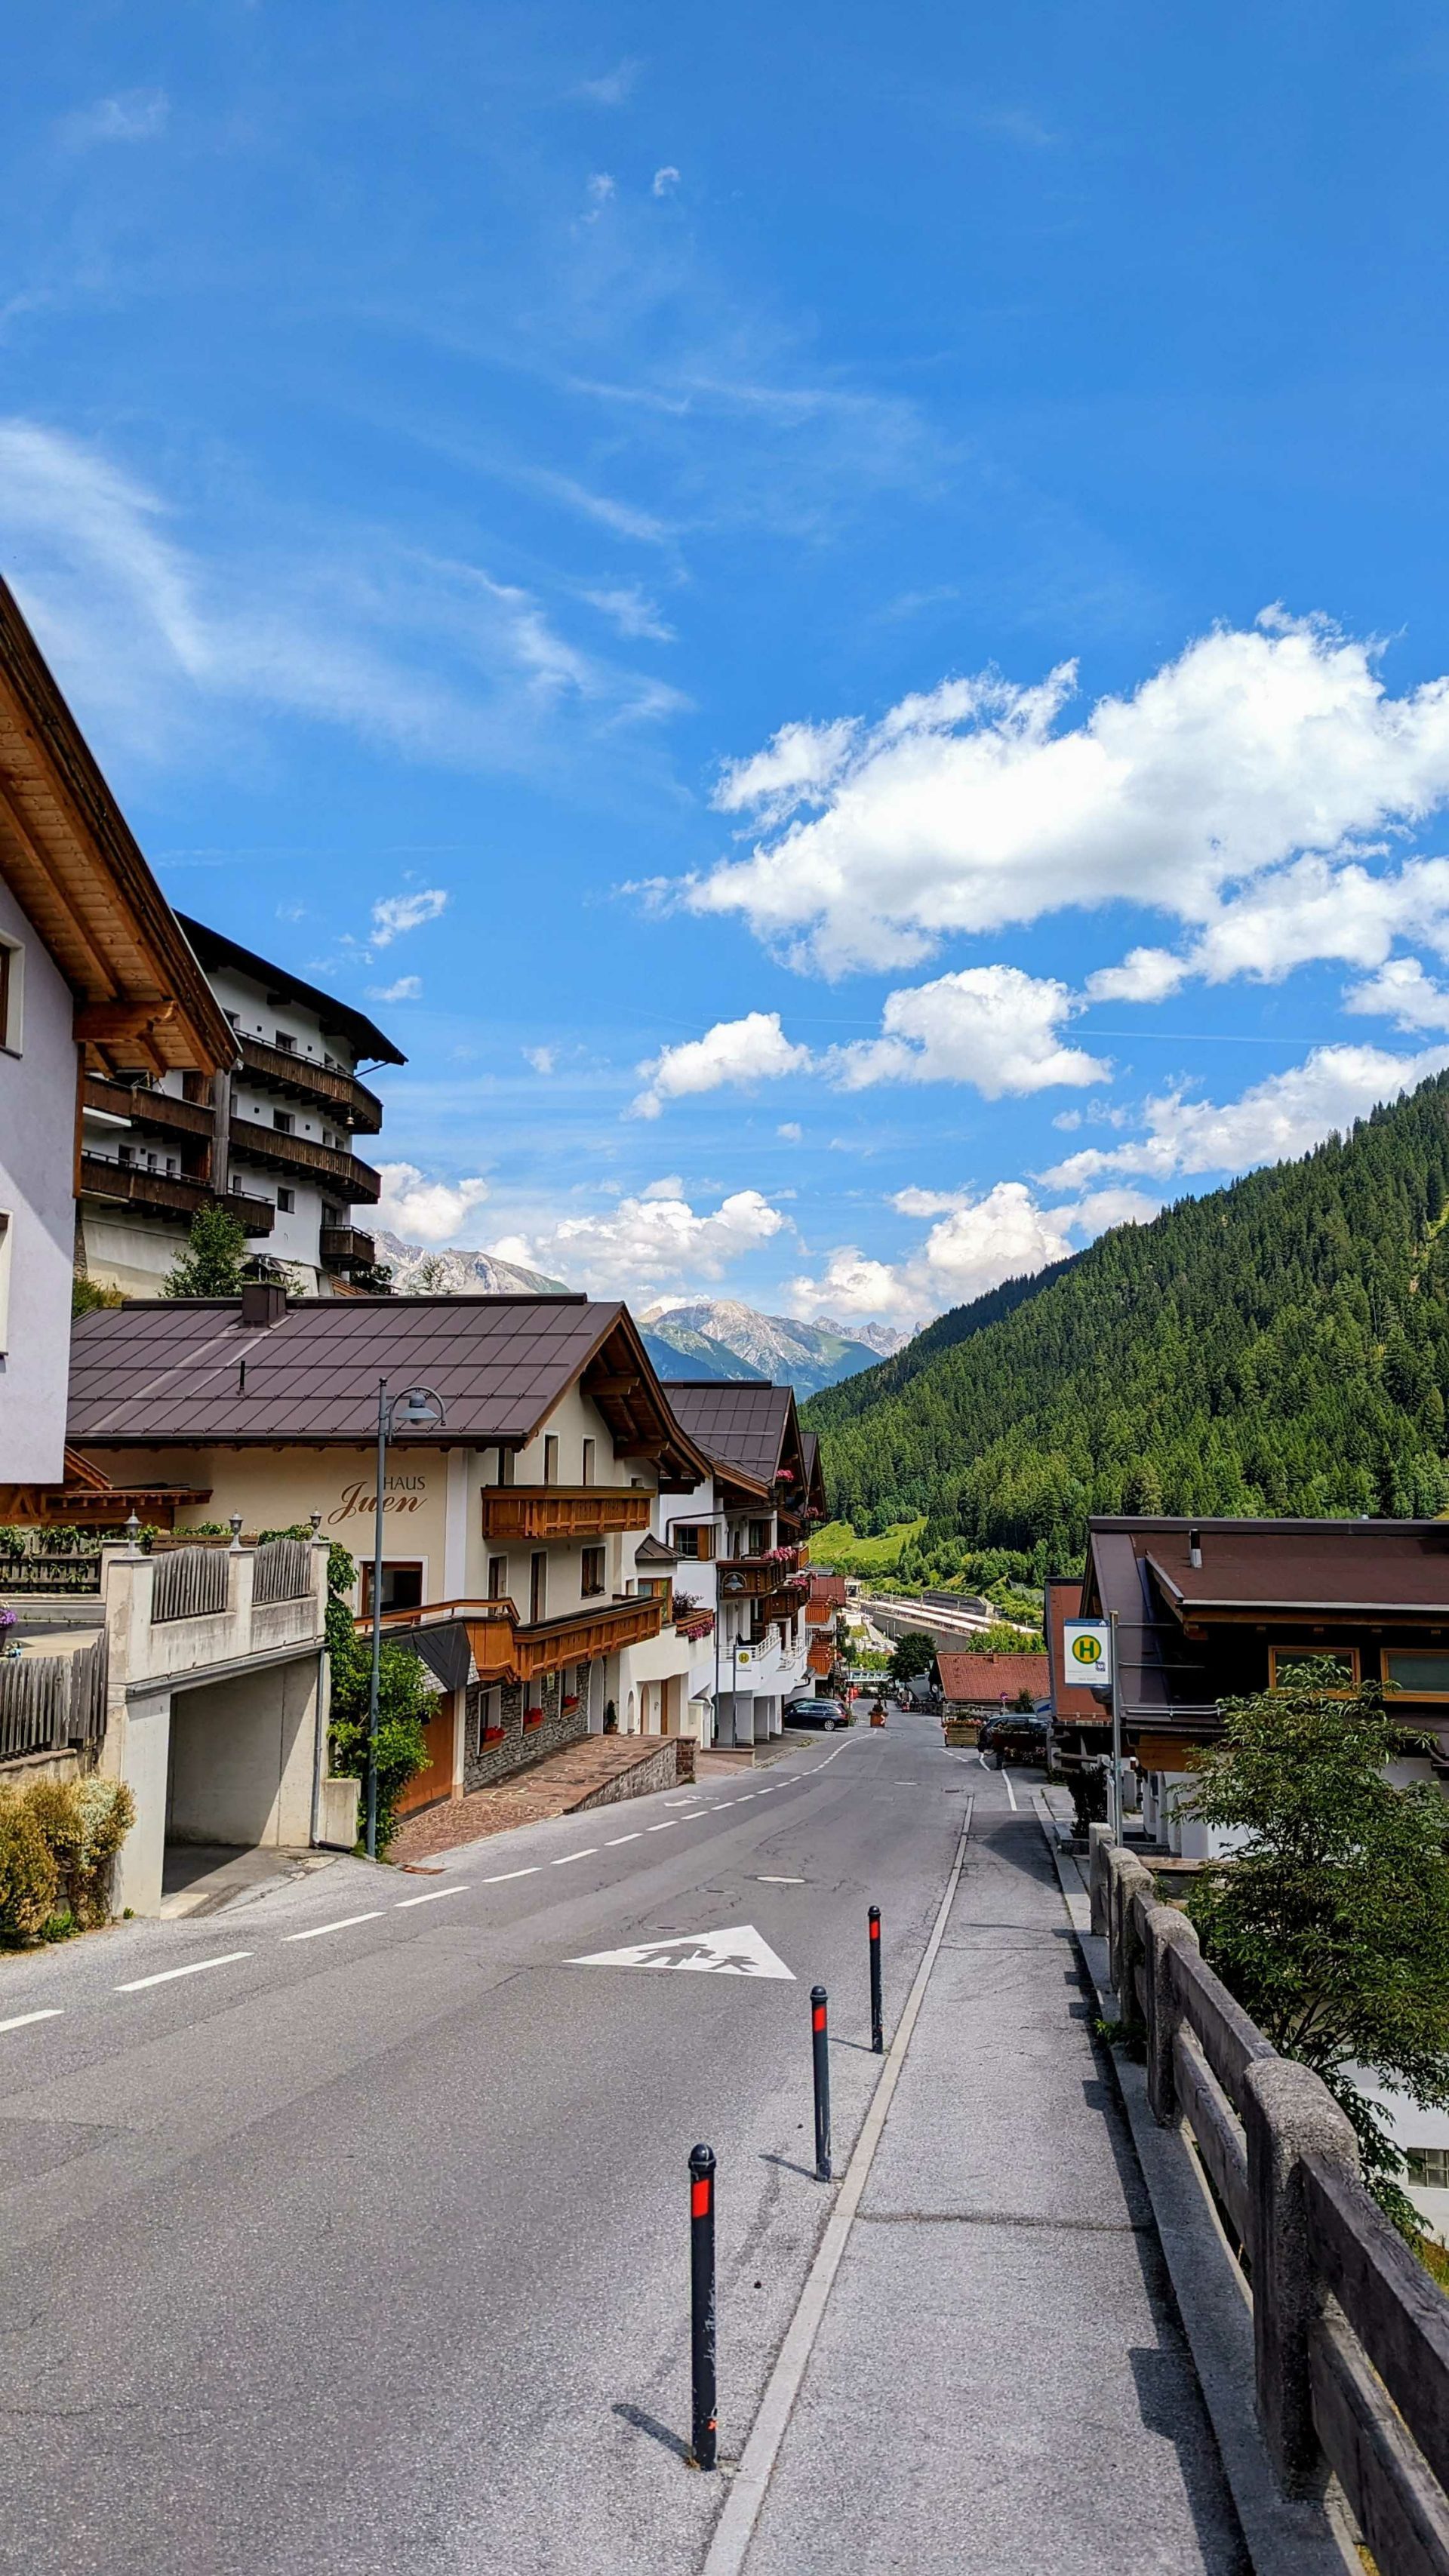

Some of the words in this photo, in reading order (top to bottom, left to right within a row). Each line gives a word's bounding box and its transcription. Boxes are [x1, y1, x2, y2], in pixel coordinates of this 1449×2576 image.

[383, 1476, 426, 1491] HAUS
[328, 1481, 428, 1525] Juen
[1079, 1640, 1094, 1659] H
